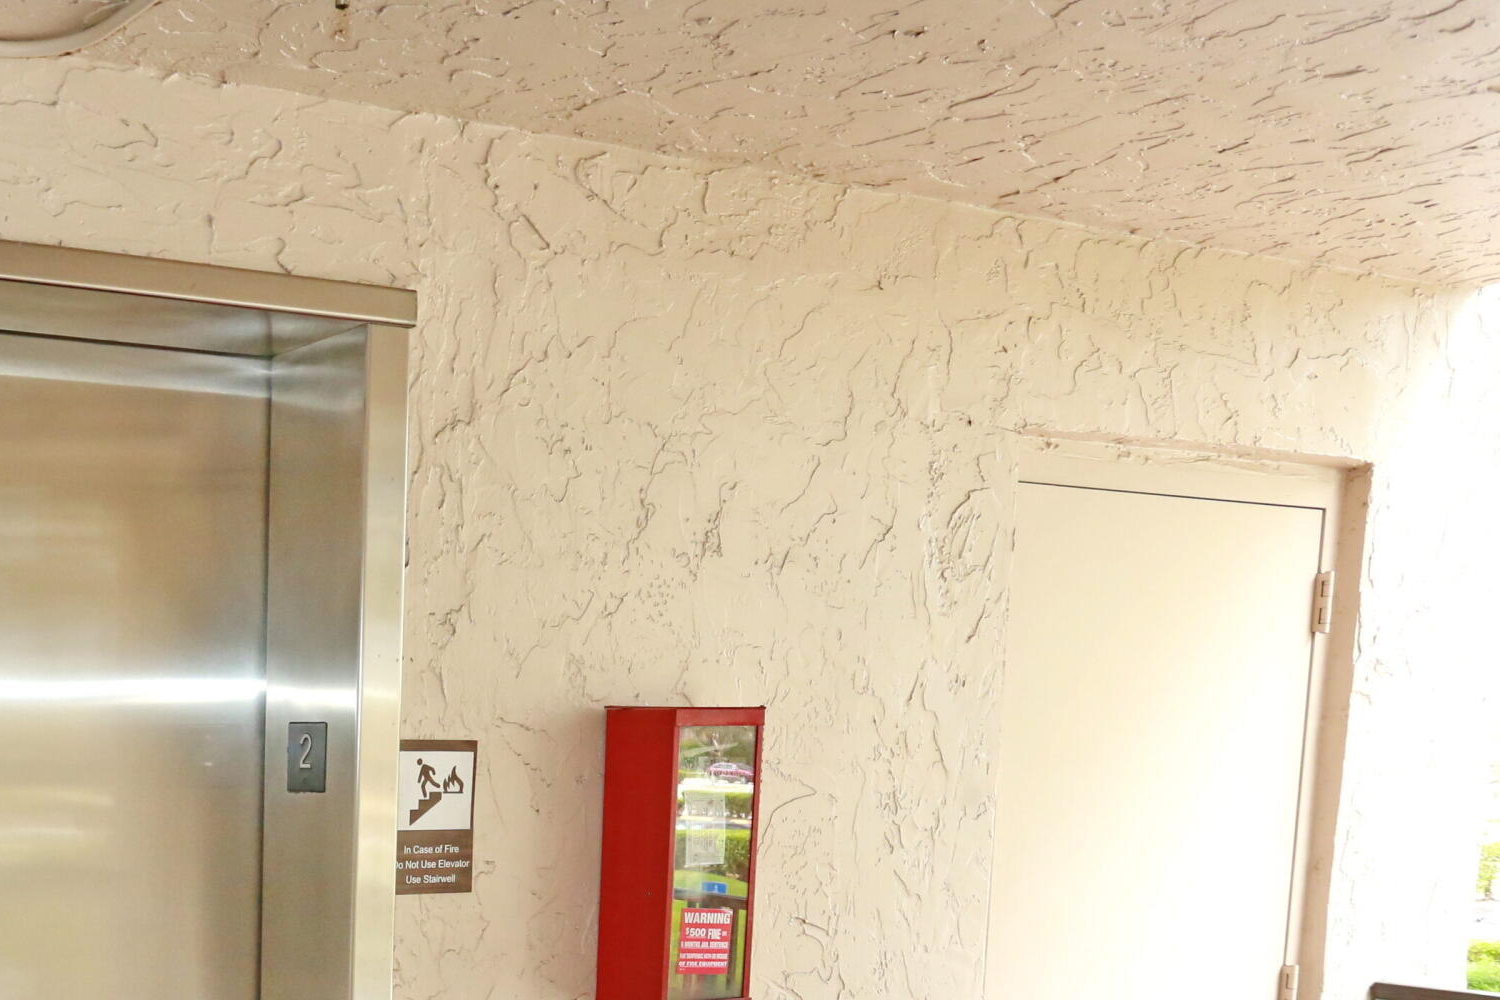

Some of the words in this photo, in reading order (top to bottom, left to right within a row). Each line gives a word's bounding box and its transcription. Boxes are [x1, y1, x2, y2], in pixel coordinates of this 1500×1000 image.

[300, 733, 312, 769] 2
[404, 845, 411, 855] In
[413, 845, 433, 854] Case
[435, 844, 443, 853] of
[445, 844, 459, 853] Fire
[405, 860, 419, 869] Not
[421, 860, 436, 869] Use
[438, 859, 469, 868] Elevator
[406, 875, 421, 884] Use
[423, 873, 456, 883] Stairwell
[684, 912, 731, 924] WARNING
[685, 927, 706, 937] $500
[707, 928, 722, 940] FINE
